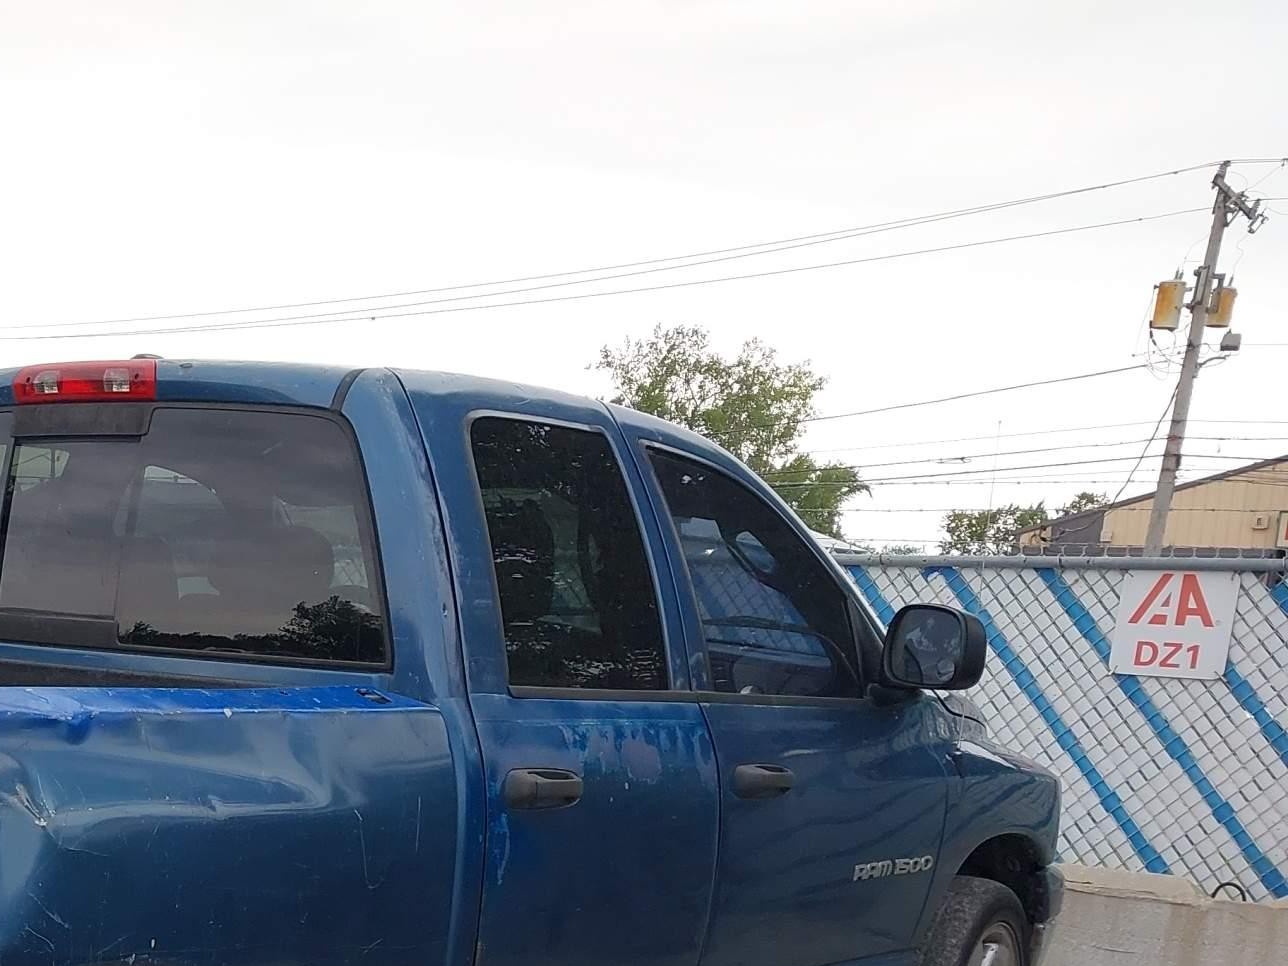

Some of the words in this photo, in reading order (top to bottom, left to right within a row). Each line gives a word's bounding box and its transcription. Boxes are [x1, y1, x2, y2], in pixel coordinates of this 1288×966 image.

[1133, 641, 1200, 669] DZ1
[853, 860, 893, 881] RAM
[895, 855, 934, 875] 1500
